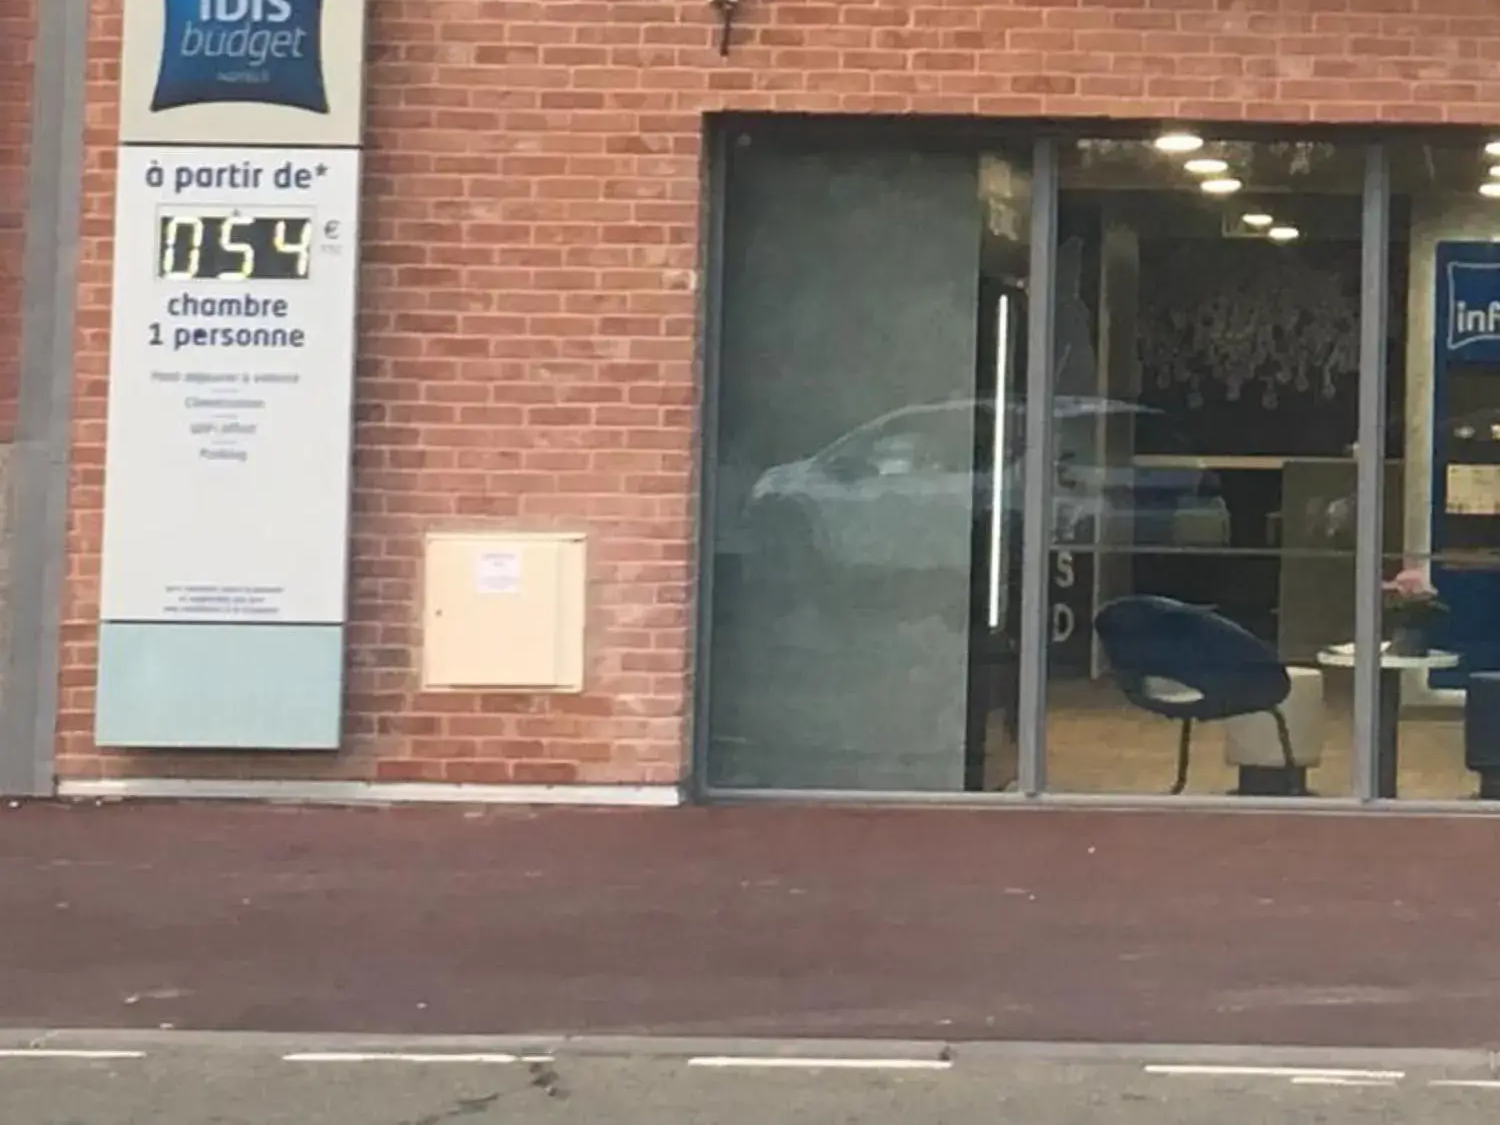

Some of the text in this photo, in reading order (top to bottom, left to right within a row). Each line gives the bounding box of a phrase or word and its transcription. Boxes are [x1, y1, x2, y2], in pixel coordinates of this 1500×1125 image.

[180, 21, 308, 67] budget
[145, 159, 164, 188] à
[174, 161, 263, 194] partir
[163, 216, 312, 281] 054
[167, 292, 288, 316] chambre
[148, 322, 305, 350] 1 personne
